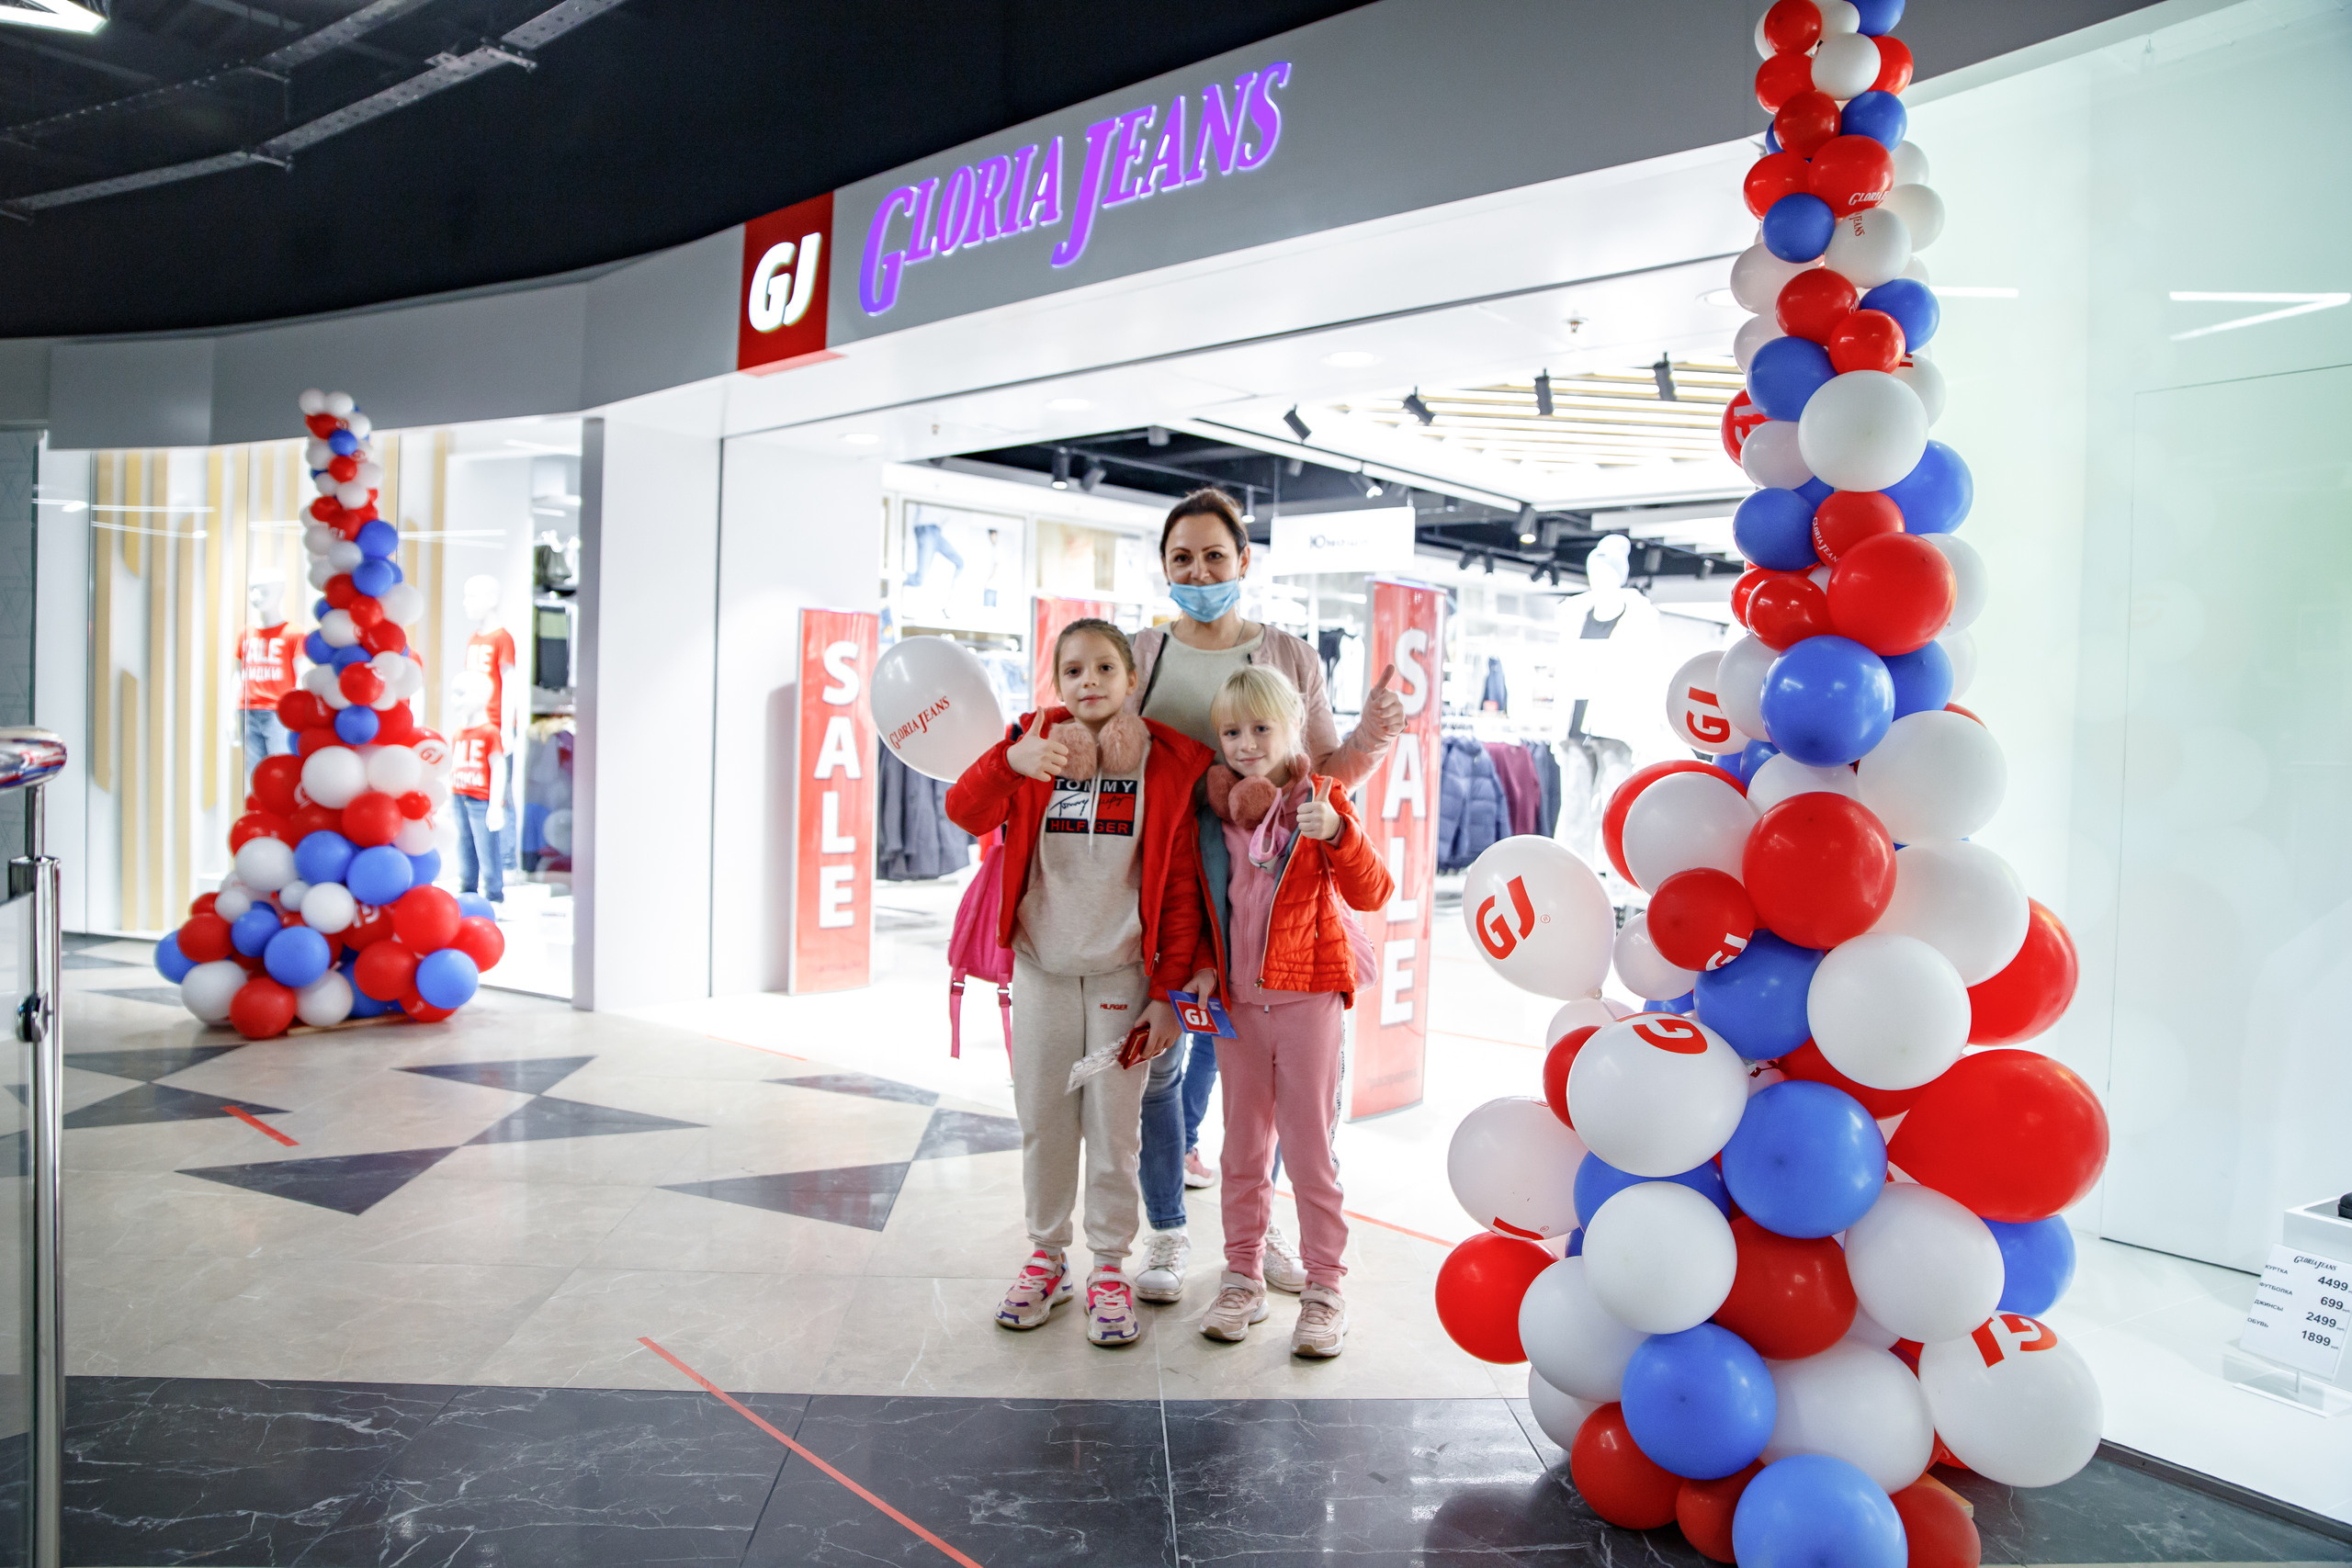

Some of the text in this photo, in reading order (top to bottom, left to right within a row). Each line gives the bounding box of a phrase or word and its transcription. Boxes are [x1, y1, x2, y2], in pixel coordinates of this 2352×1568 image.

[860, 62, 1292, 316] GLORIA JEANS
[749, 232, 821, 333] GJ
[1817, 544, 1839, 562] JEAN
[889, 695, 950, 750] GLORIA JEANS
[814, 640, 862, 929] SALE
[1050, 819, 1129, 834] HILFGER
[1380, 627, 1428, 1027] SALE
[1476, 874, 1535, 960] GJ
[1184, 1008, 1208, 1026] GJ
[2293, 1256, 2338, 1270] GLORIA JEANS
[2265, 1265, 2289, 1275] КУРТКА
[2317, 1276, 2348, 1292] 4499
[2259, 1281, 2293, 1295] ФУТБОЛКА
[2320, 1296, 2344, 1310] 699
[2254, 1299, 2336, 1328] ДЖИНСЫ 2499
[2247, 1317, 2331, 1347] ОБУВЬ 1899
